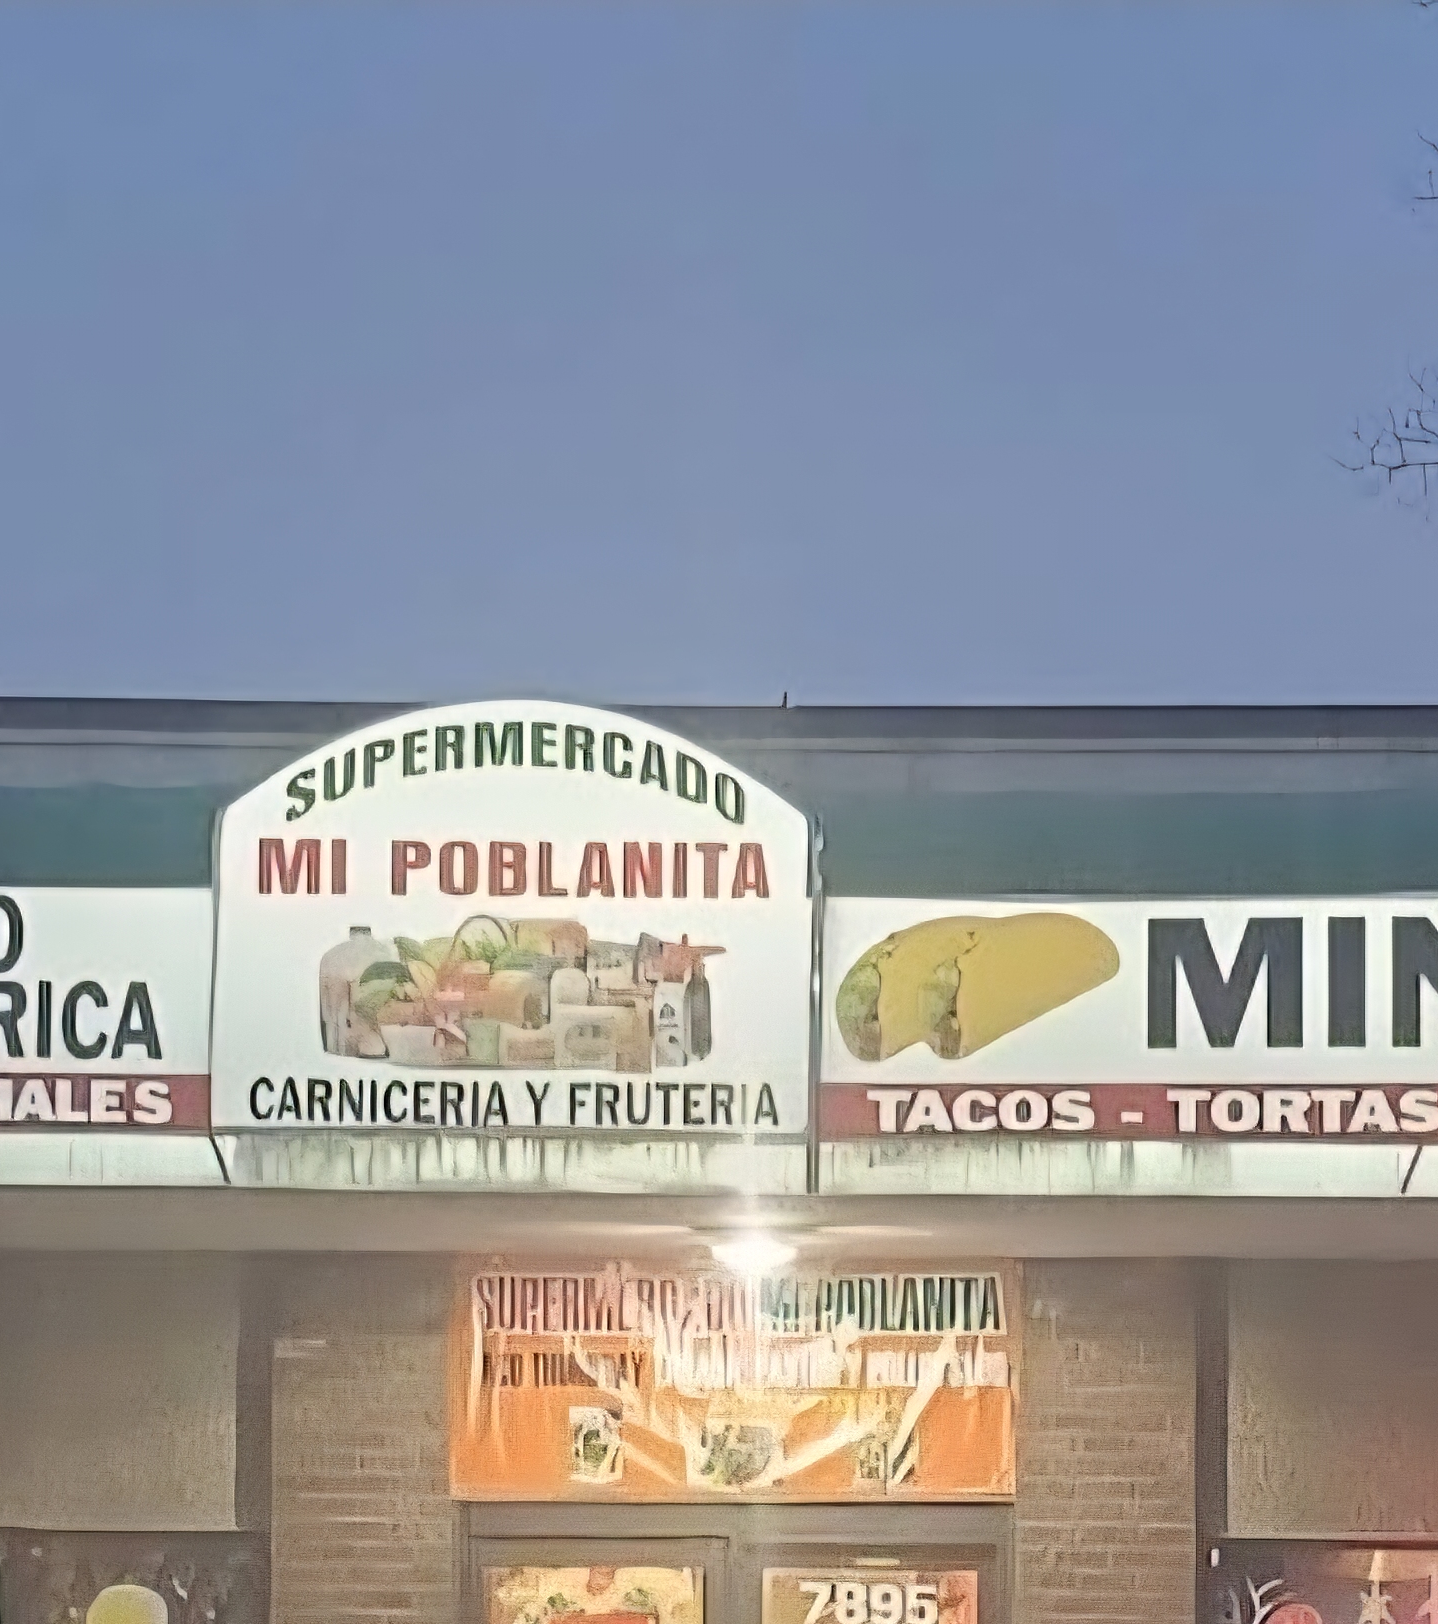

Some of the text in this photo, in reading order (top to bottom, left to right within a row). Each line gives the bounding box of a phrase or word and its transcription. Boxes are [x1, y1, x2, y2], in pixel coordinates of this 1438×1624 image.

[285, 720, 747, 824] SUPERMERCADO
[259, 838, 770, 899] MI POBLANITA
[249, 1076, 779, 1127] CARNICERIA Y FRUTERIA
[867, 1089, 1095, 1133] TACOS
